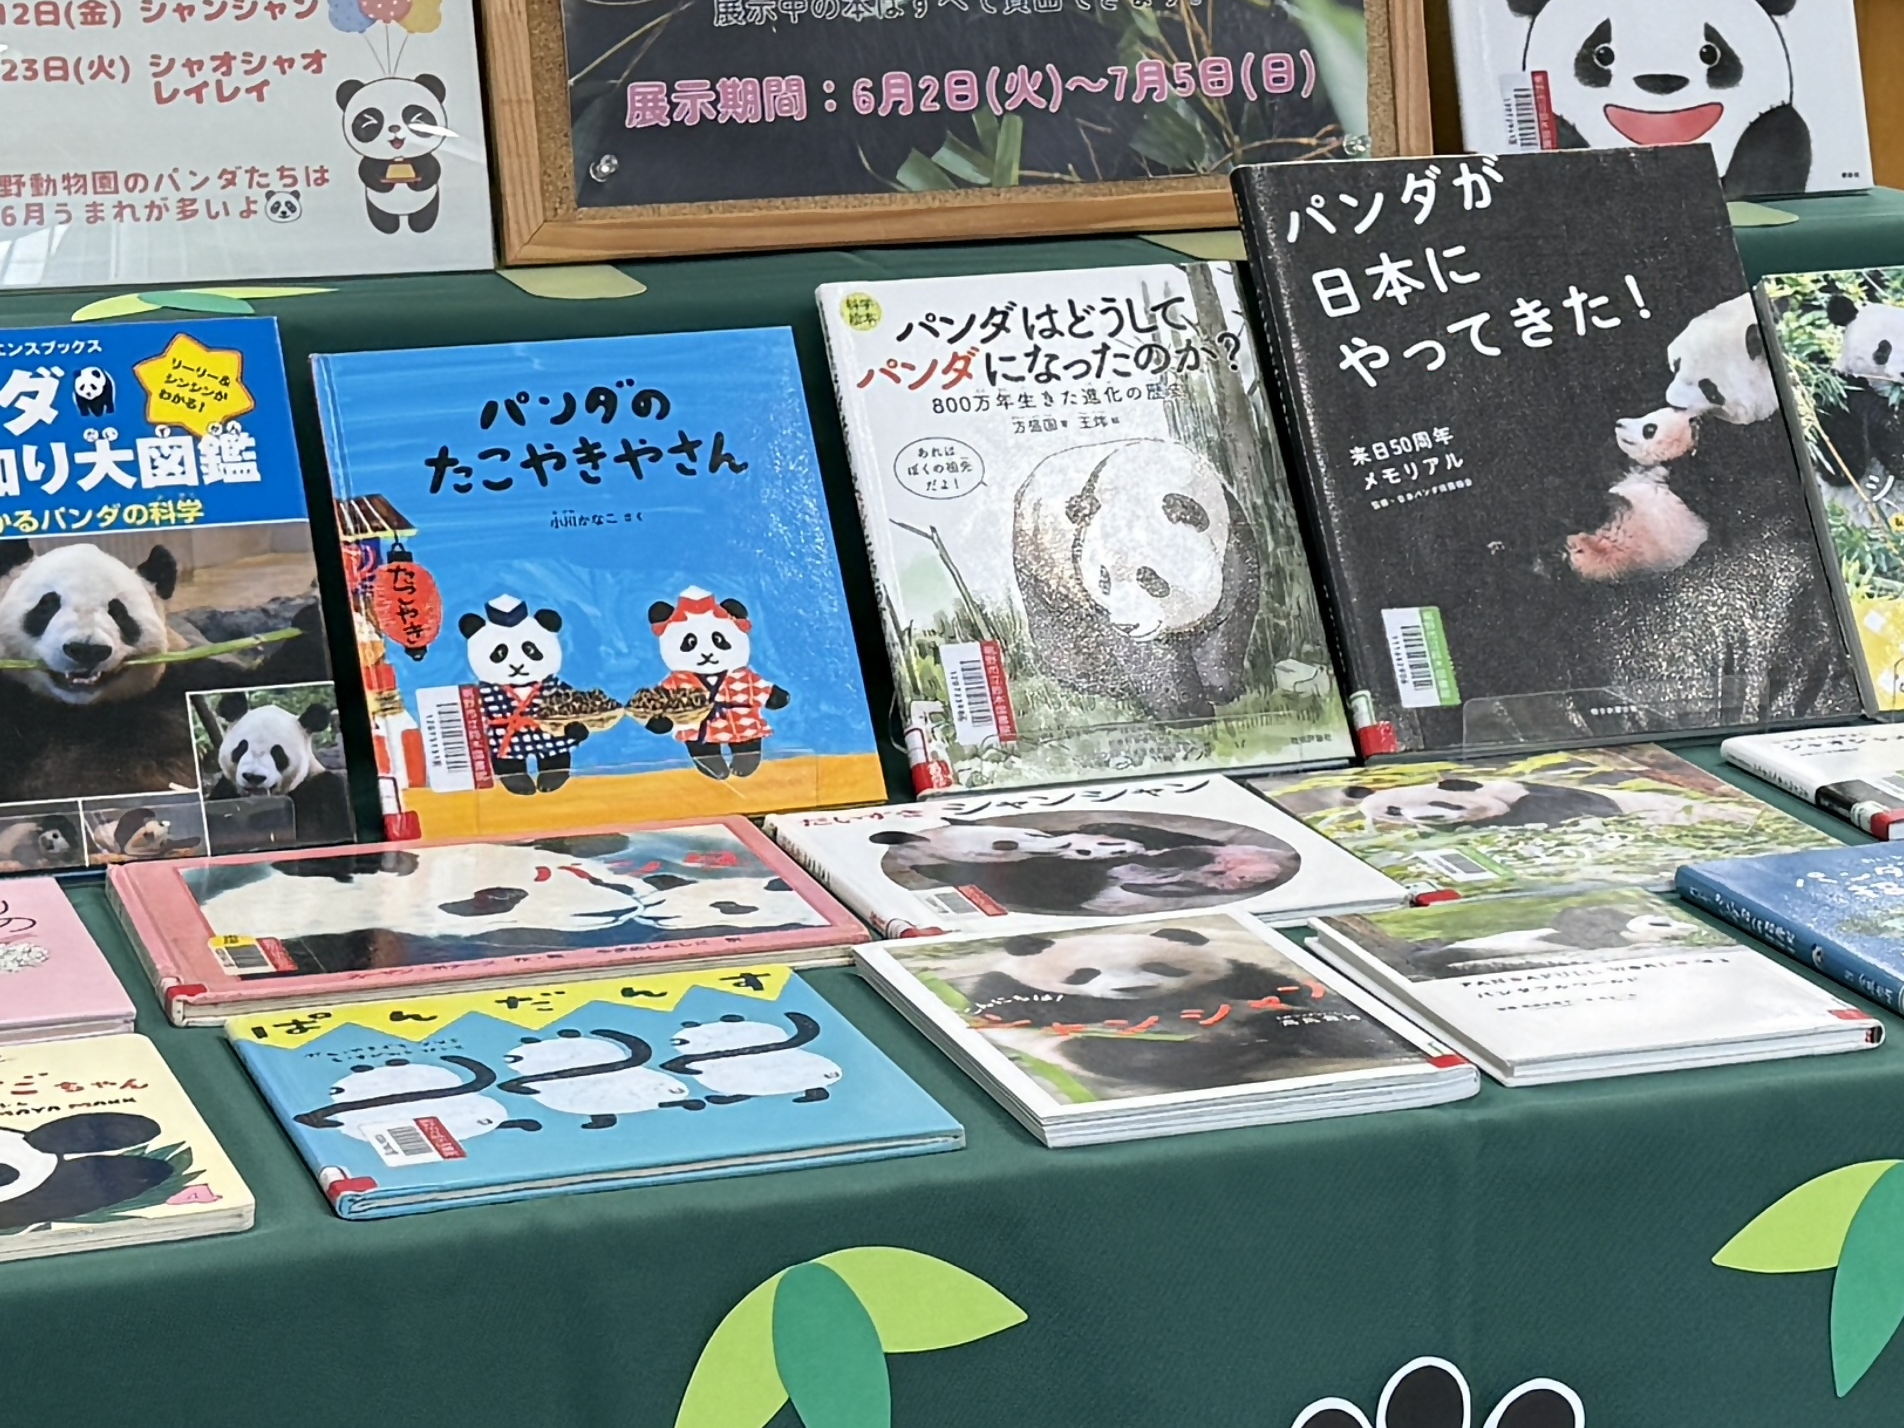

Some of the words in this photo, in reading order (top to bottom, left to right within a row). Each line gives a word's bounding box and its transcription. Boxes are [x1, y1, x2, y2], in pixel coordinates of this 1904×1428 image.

[148, 48, 328, 80] シャオシャオ
[152, 78, 271, 106] レイレイ
[0, 194, 261, 229] 6月うまれが多いよ
[1286, 154, 1506, 245] パンダが
[1311, 243, 1483, 319] 日本に
[896, 295, 1189, 345] パンダはどうして
[1337, 273, 1654, 390] やってきた！
[856, 330, 1242, 390] パンダになったのか？
[480, 377, 672, 430] パンダの
[424, 429, 749, 494] たこやきやさん
[917, 445, 955, 459] あれは
[1349, 426, 1455, 467] 来日50周年
[1364, 452, 1464, 491] メモリアル
[549, 510, 619, 530] 小川かなこ
[387, 565, 426, 647] たこやき
[940, 779, 1211, 816] シャンシャン
[250, 971, 773, 1040] ぱんだんす
